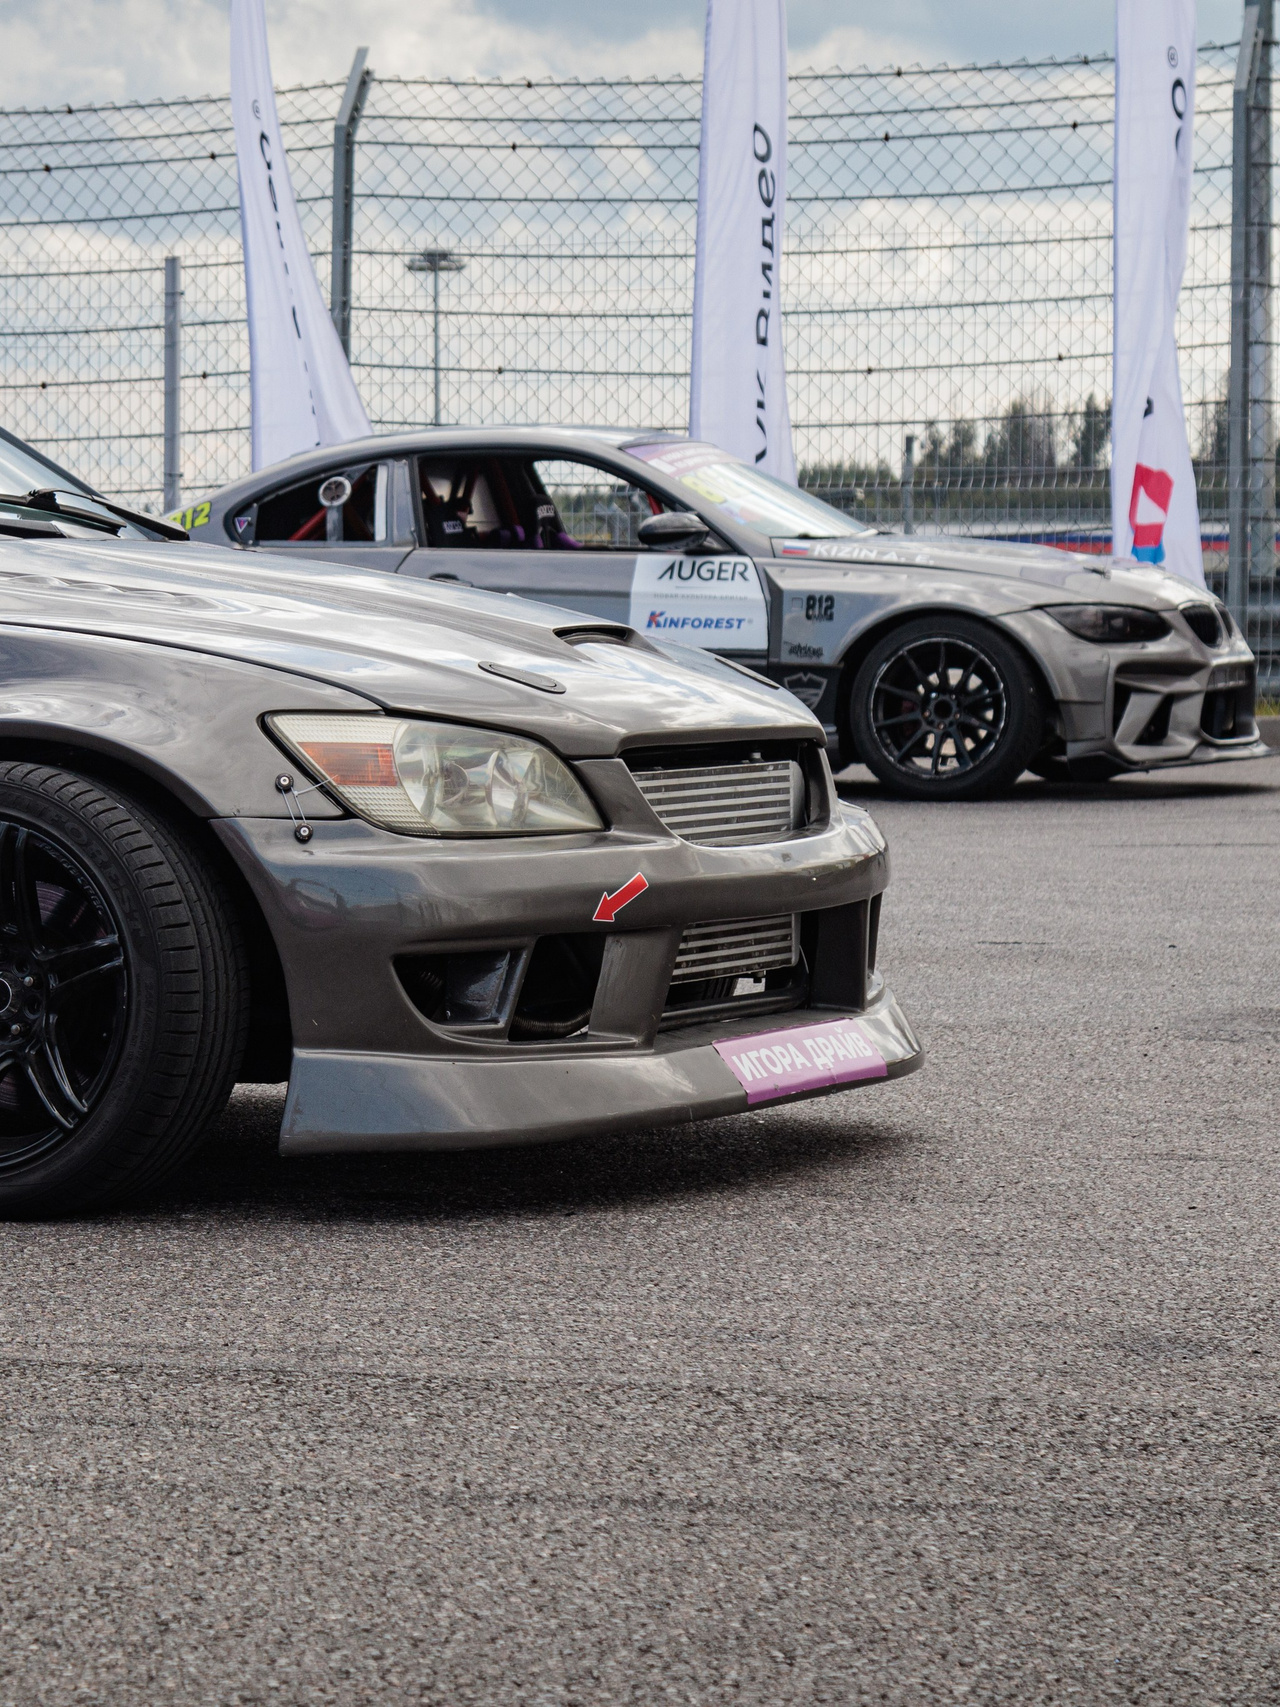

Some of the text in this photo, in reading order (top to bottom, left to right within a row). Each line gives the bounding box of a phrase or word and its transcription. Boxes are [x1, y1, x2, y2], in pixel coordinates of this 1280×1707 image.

[813, 544, 879, 559] KIZIN
[657, 559, 749, 582] AUGER
[646, 610, 746, 630] KINFOREST
[731, 1026, 873, 1082] ИГОРА ДРАЙВ
